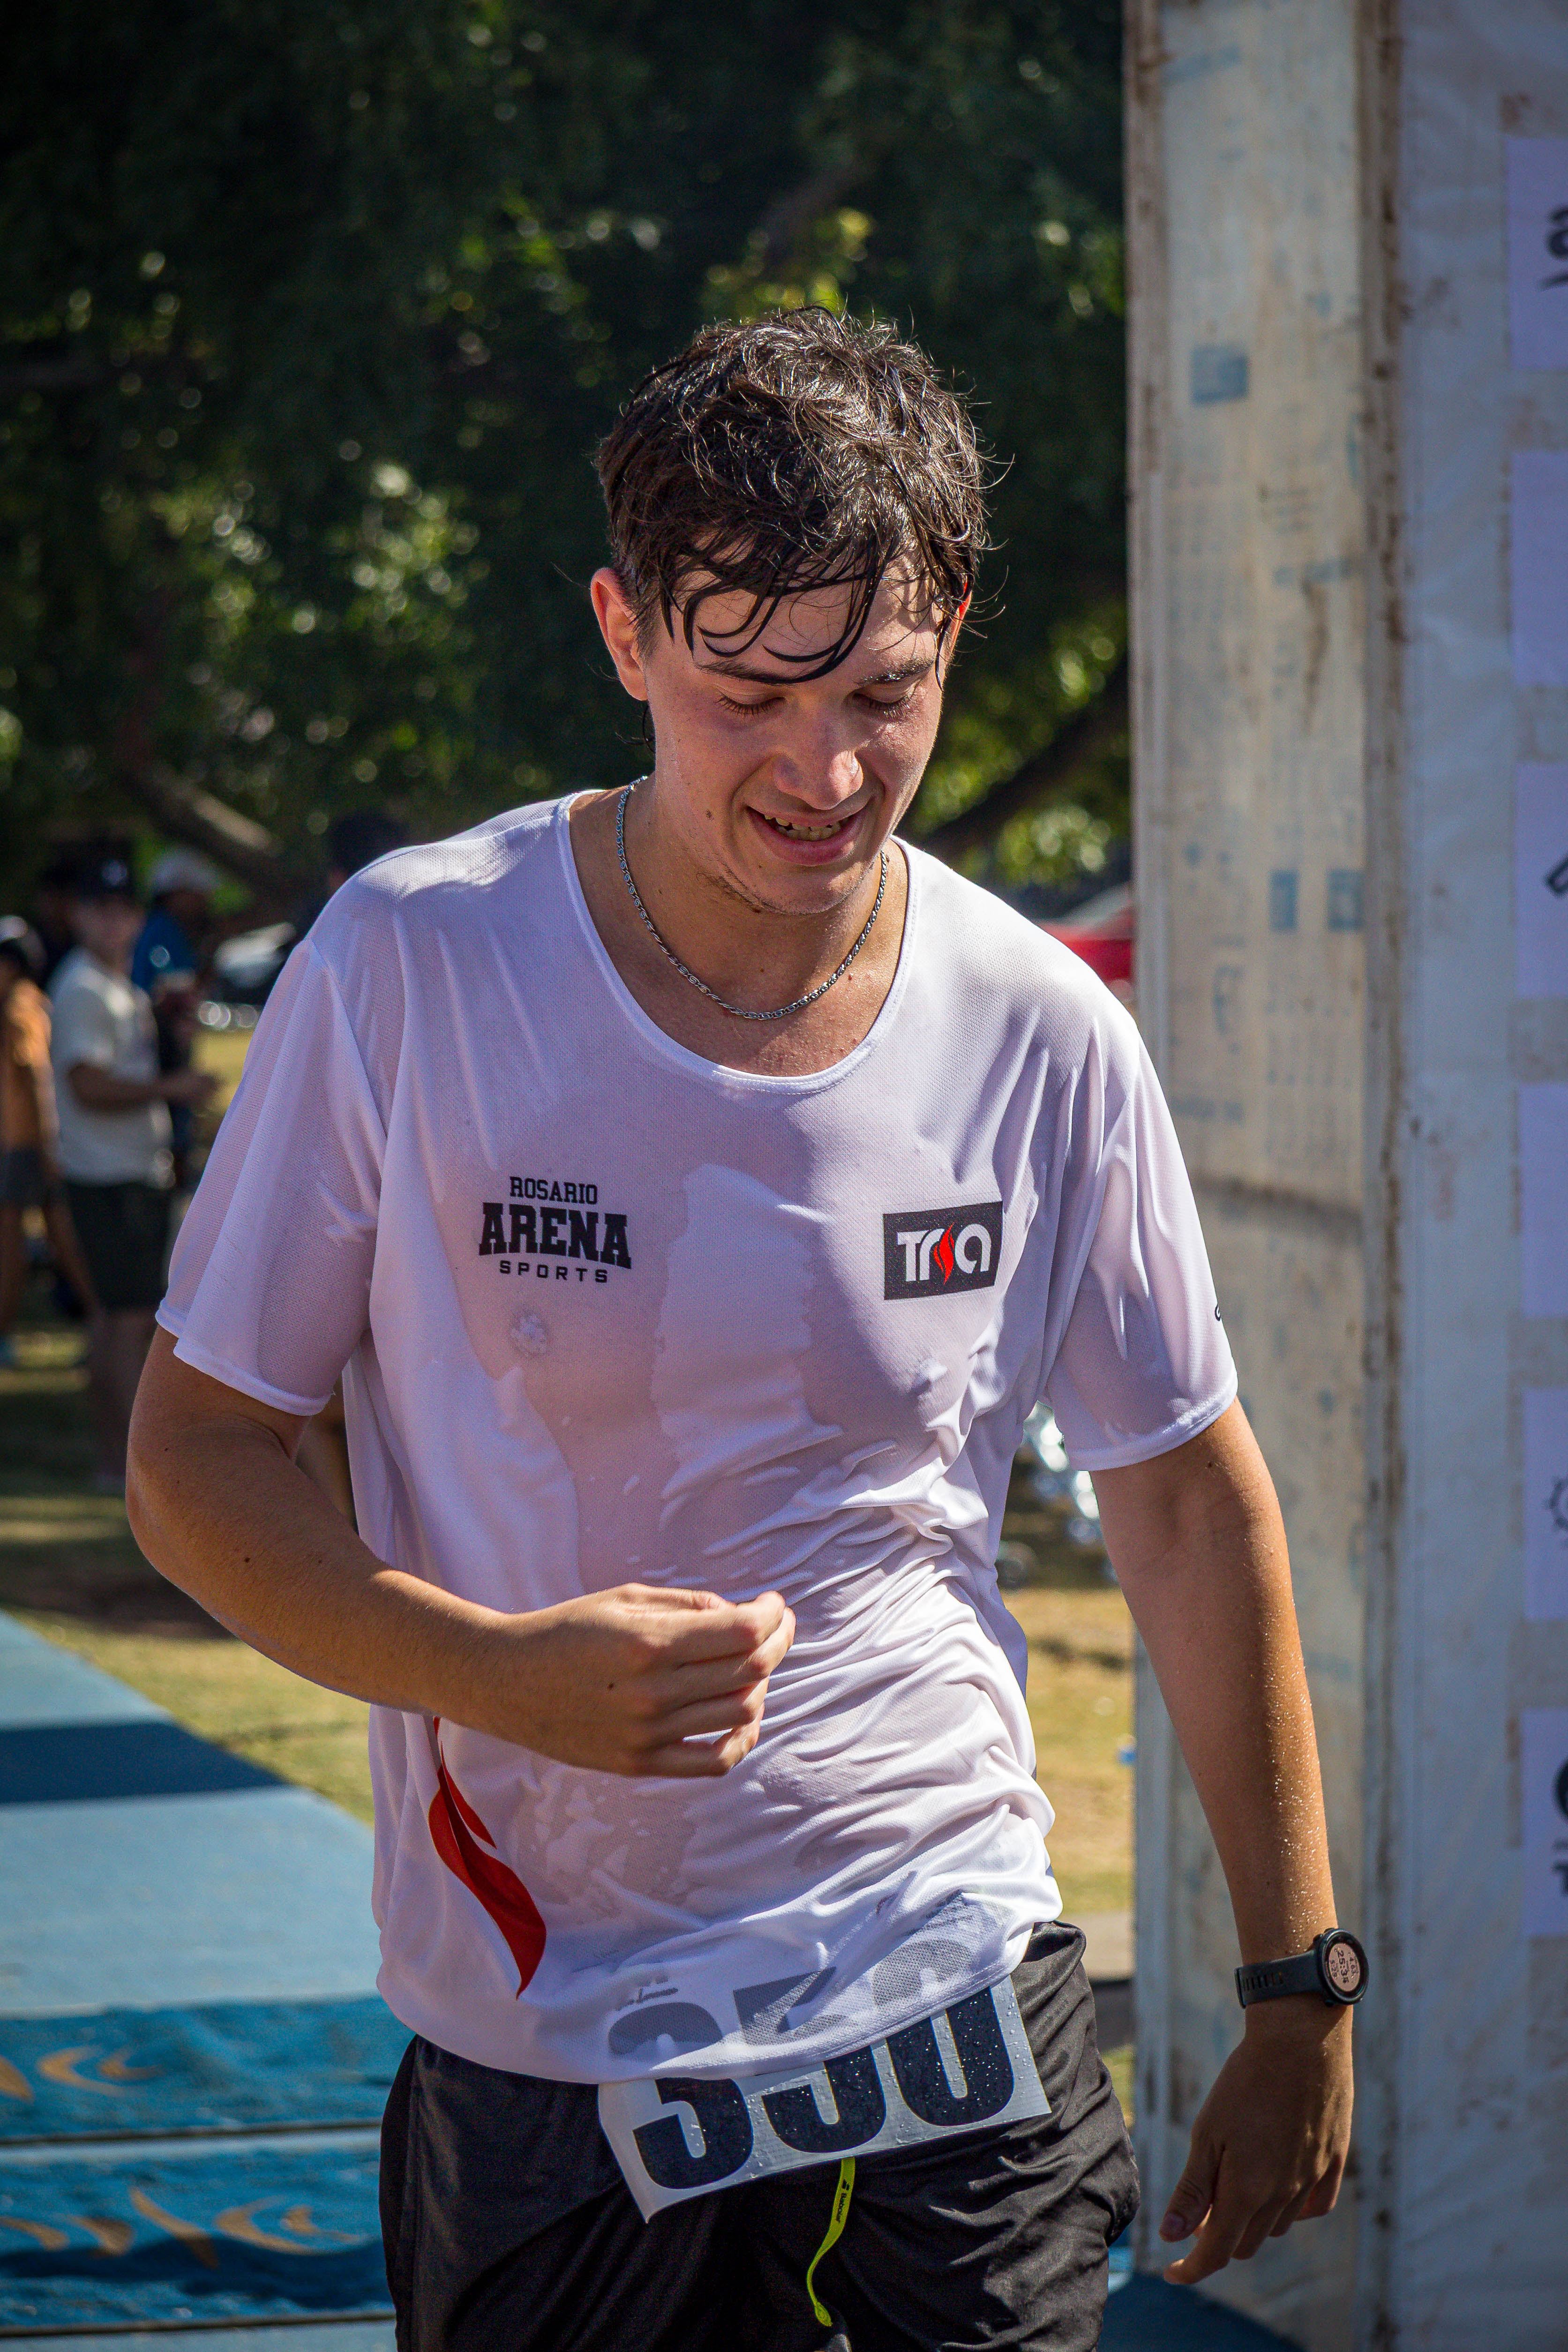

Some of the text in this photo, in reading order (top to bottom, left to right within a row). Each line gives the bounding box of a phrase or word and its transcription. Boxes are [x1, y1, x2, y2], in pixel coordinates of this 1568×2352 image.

[510, 1176, 599, 1205] ROSARIO
[479, 1201, 632, 1270] ARENA
[499, 1260, 608, 1283] SPORTS
